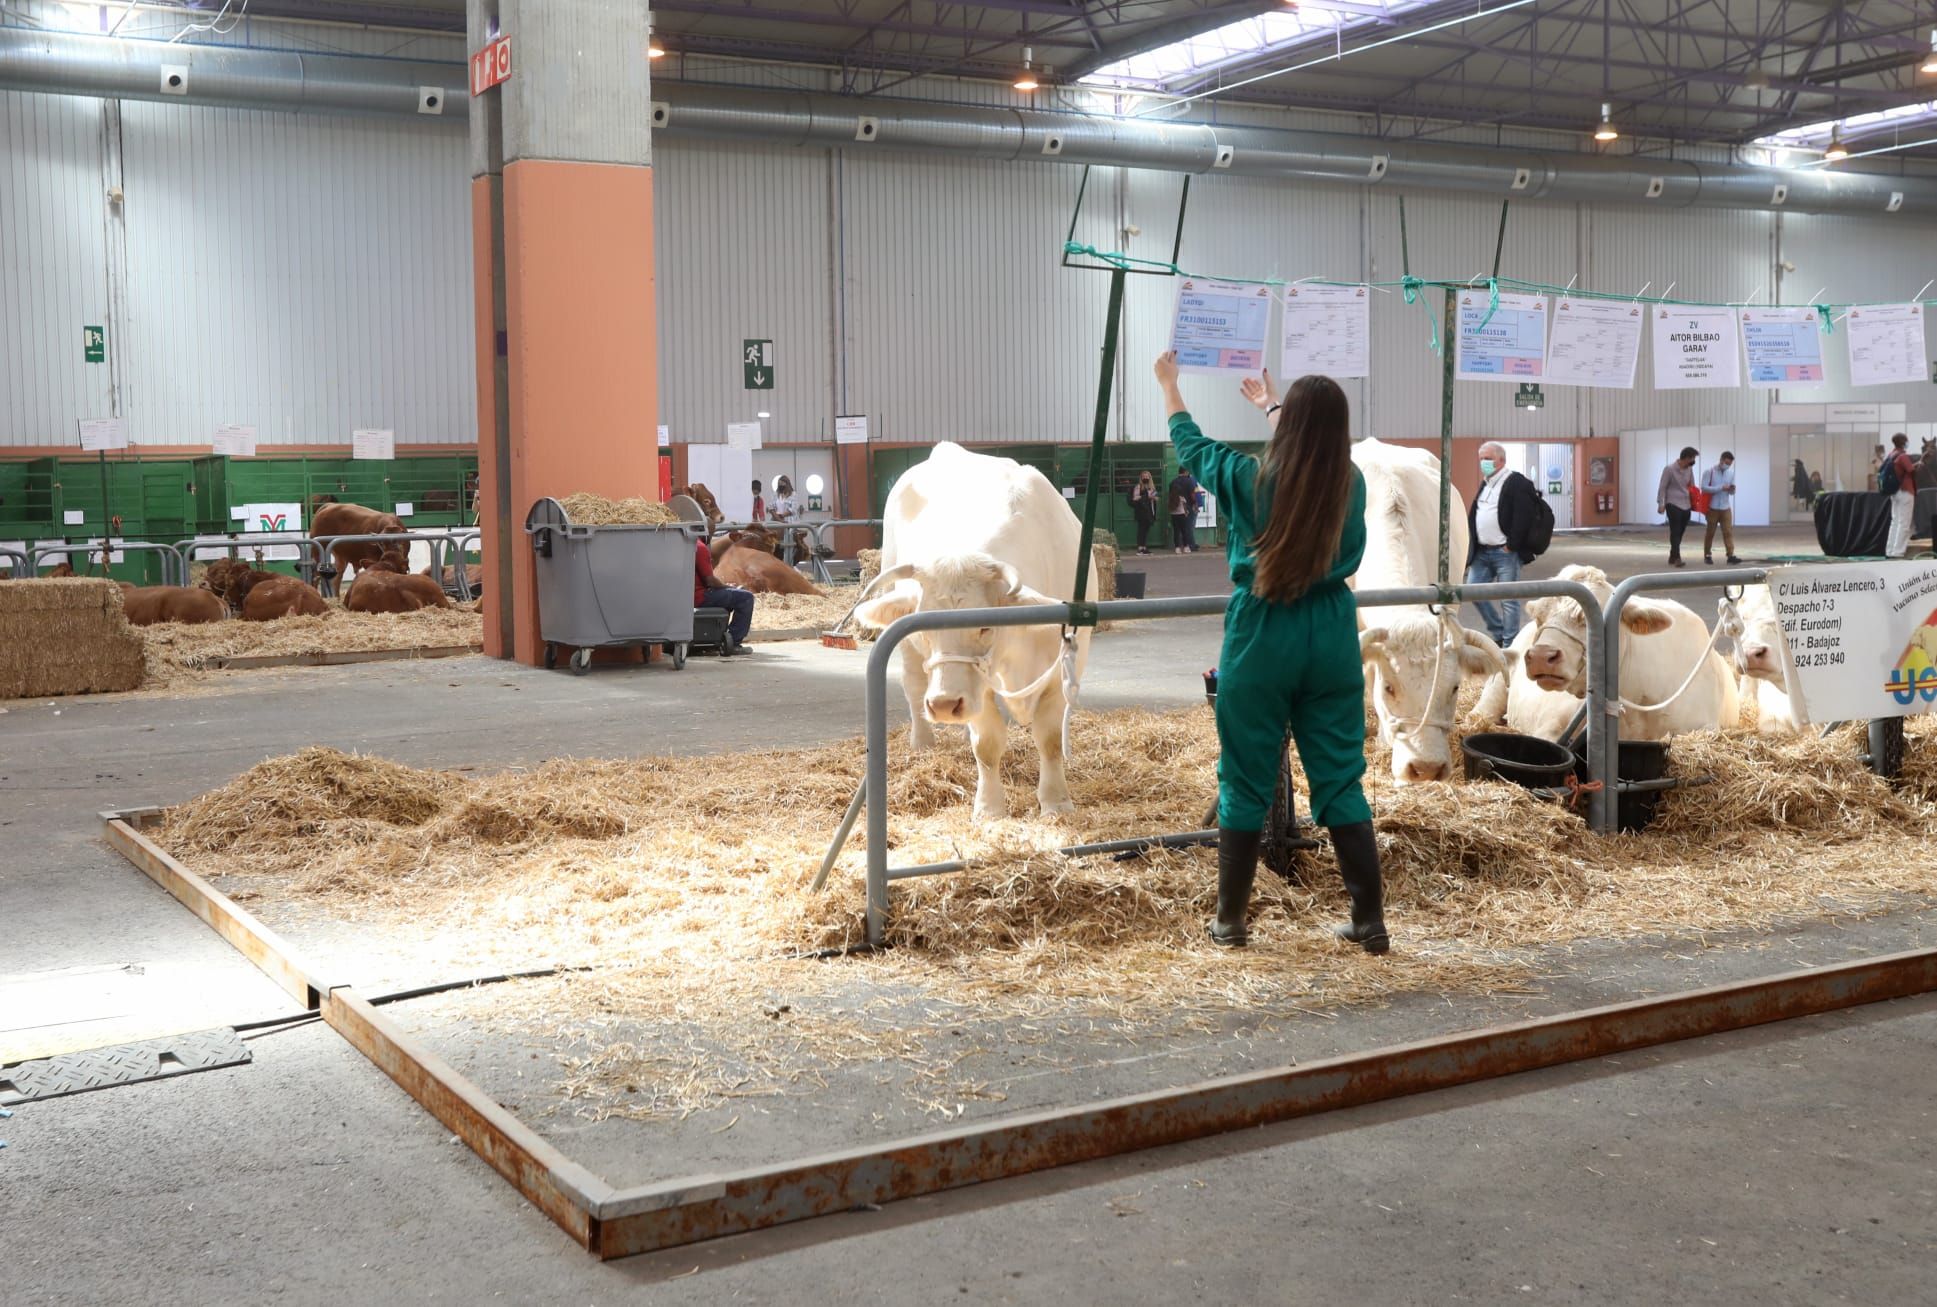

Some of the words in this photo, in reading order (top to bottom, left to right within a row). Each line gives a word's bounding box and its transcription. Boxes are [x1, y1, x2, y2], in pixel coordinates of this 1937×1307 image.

[1689, 320, 1699, 329] ZV
[1670, 333, 1692, 342] AITOR
[1692, 332, 1720, 342] BILBAO
[1682, 344, 1708, 353] GARAY
[1779, 583, 1789, 596] C/
[1790, 582, 1809, 595] Luis
[1811, 579, 1842, 595] Álvarez
[1843, 579, 1878, 592] Lencero,
[1879, 578, 1886, 591] 3
[1898, 576, 1921, 593] Unión
[1922, 571, 1931, 581] de
[1777, 601, 1820, 616] Despacho
[1822, 599, 1835, 612] 7-3
[1892, 592, 1919, 613] Vacuno
[1800, 616, 1842, 632] Eurodom)
[1806, 635, 1840, 650] Badajoz
[1795, 654, 1811, 667] 924
[1814, 653, 1828, 666] 253
[1829, 652, 1845, 665] 940
